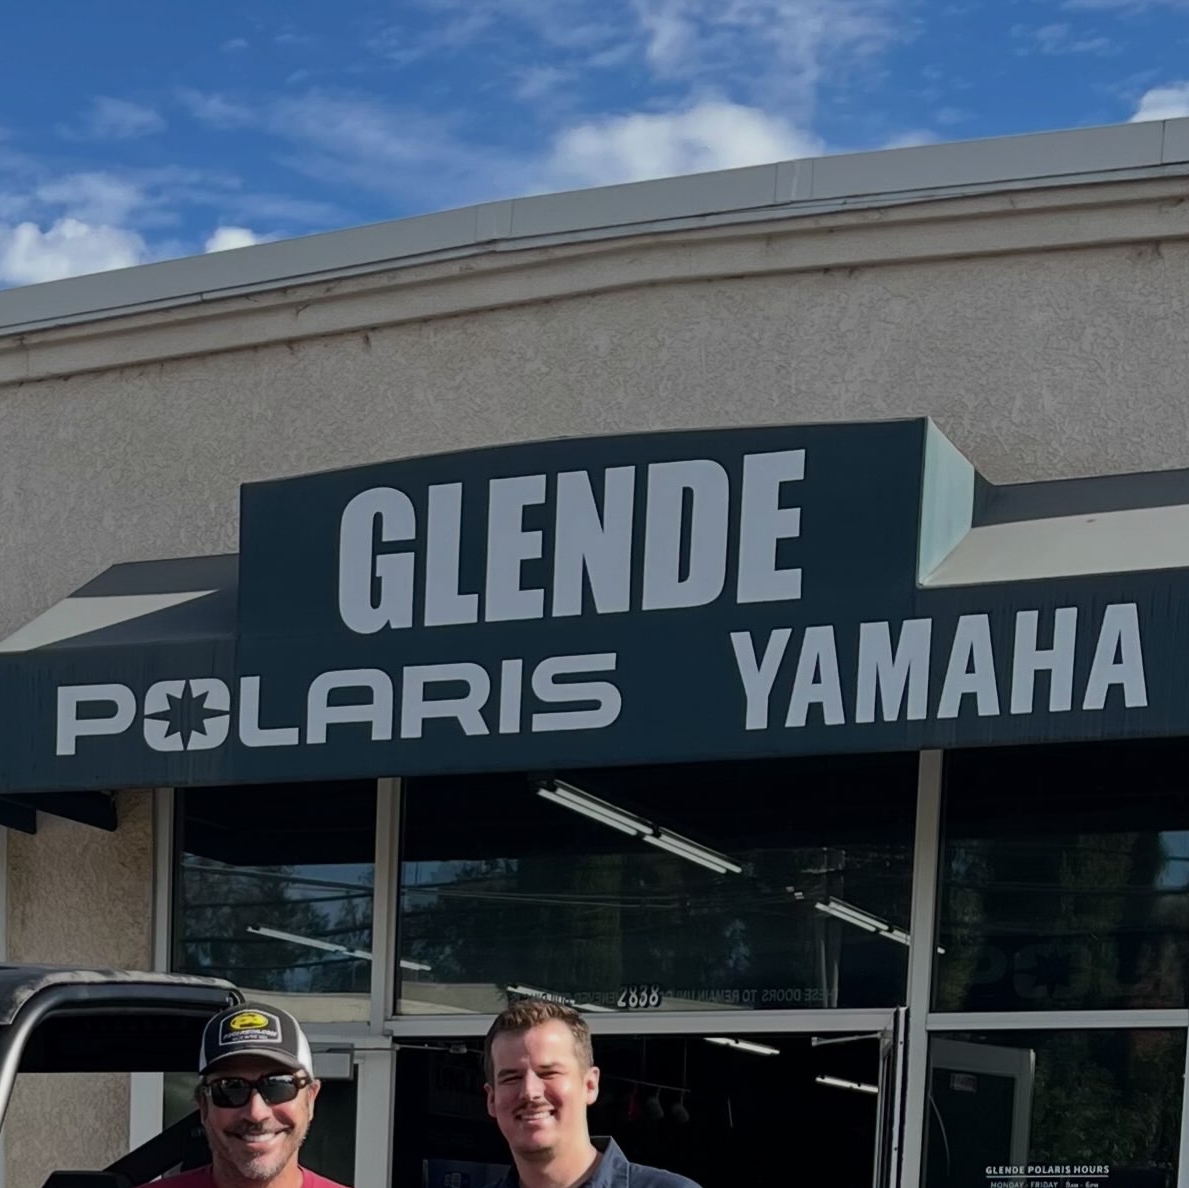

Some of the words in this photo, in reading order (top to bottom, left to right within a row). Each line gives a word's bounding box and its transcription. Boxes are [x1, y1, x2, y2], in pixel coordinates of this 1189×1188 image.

[339, 449, 805, 634] GLENDE
[730, 603, 1148, 730] YAMAHA
[56, 652, 623, 756] POLARIS
[617, 983, 660, 1008] 2838
[985, 1165, 1025, 1175] GLENDE
[1027, 1164, 1071, 1175] POLARIS
[1073, 1164, 1110, 1175] HOURS
[1030, 1180, 1058, 1188] FRIDAY
